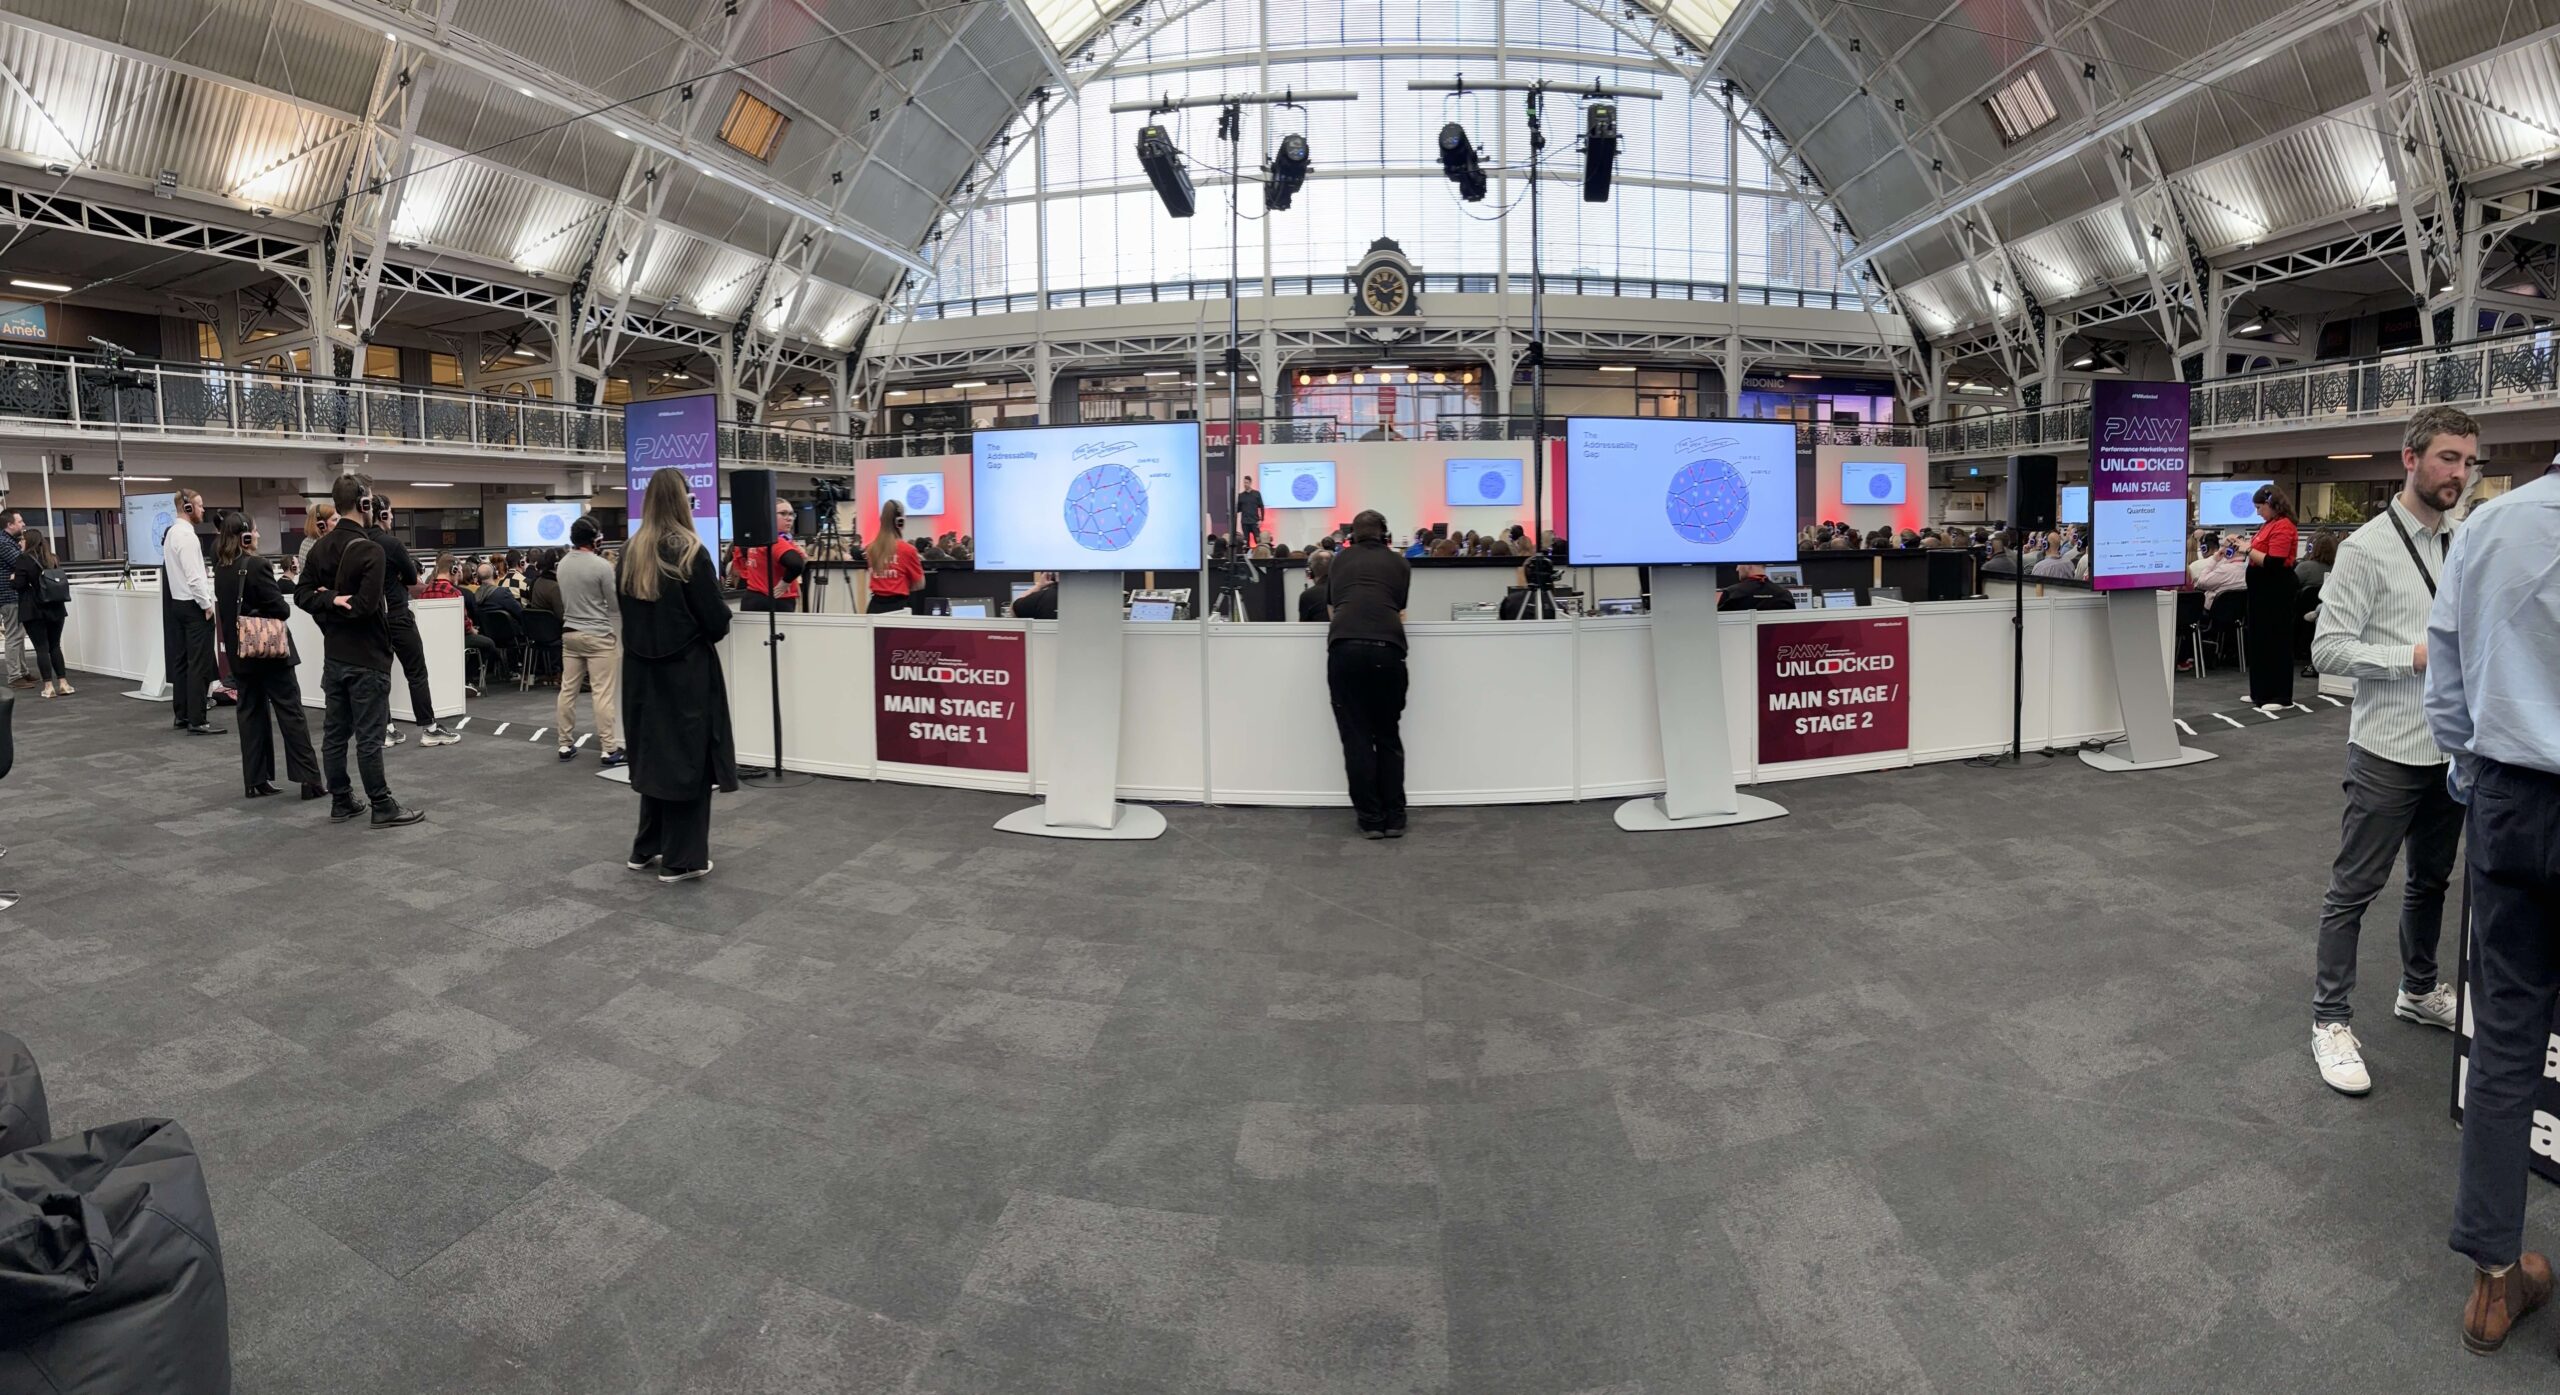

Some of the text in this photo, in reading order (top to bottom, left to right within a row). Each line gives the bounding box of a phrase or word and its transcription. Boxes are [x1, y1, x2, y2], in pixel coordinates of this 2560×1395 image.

[3, 322, 46, 338] Amefa
[1742, 378, 1785, 388] RIDONIC
[1583, 431, 1598, 439] The
[2104, 416, 2182, 442] PMW
[634, 433, 709, 462] PMW
[986, 461, 1002, 470] Gap
[2112, 482, 2171, 493] MAIN STAGE
[2126, 507, 2156, 515] Quantcast
[1777, 644, 1829, 660] PMW
[1769, 683, 1899, 711] MAIN STAGE /
[884, 695, 1015, 720] MAIN STAGE /
[1795, 711, 1873, 735] STAGE 2
[909, 722, 988, 743] STAGE 1
